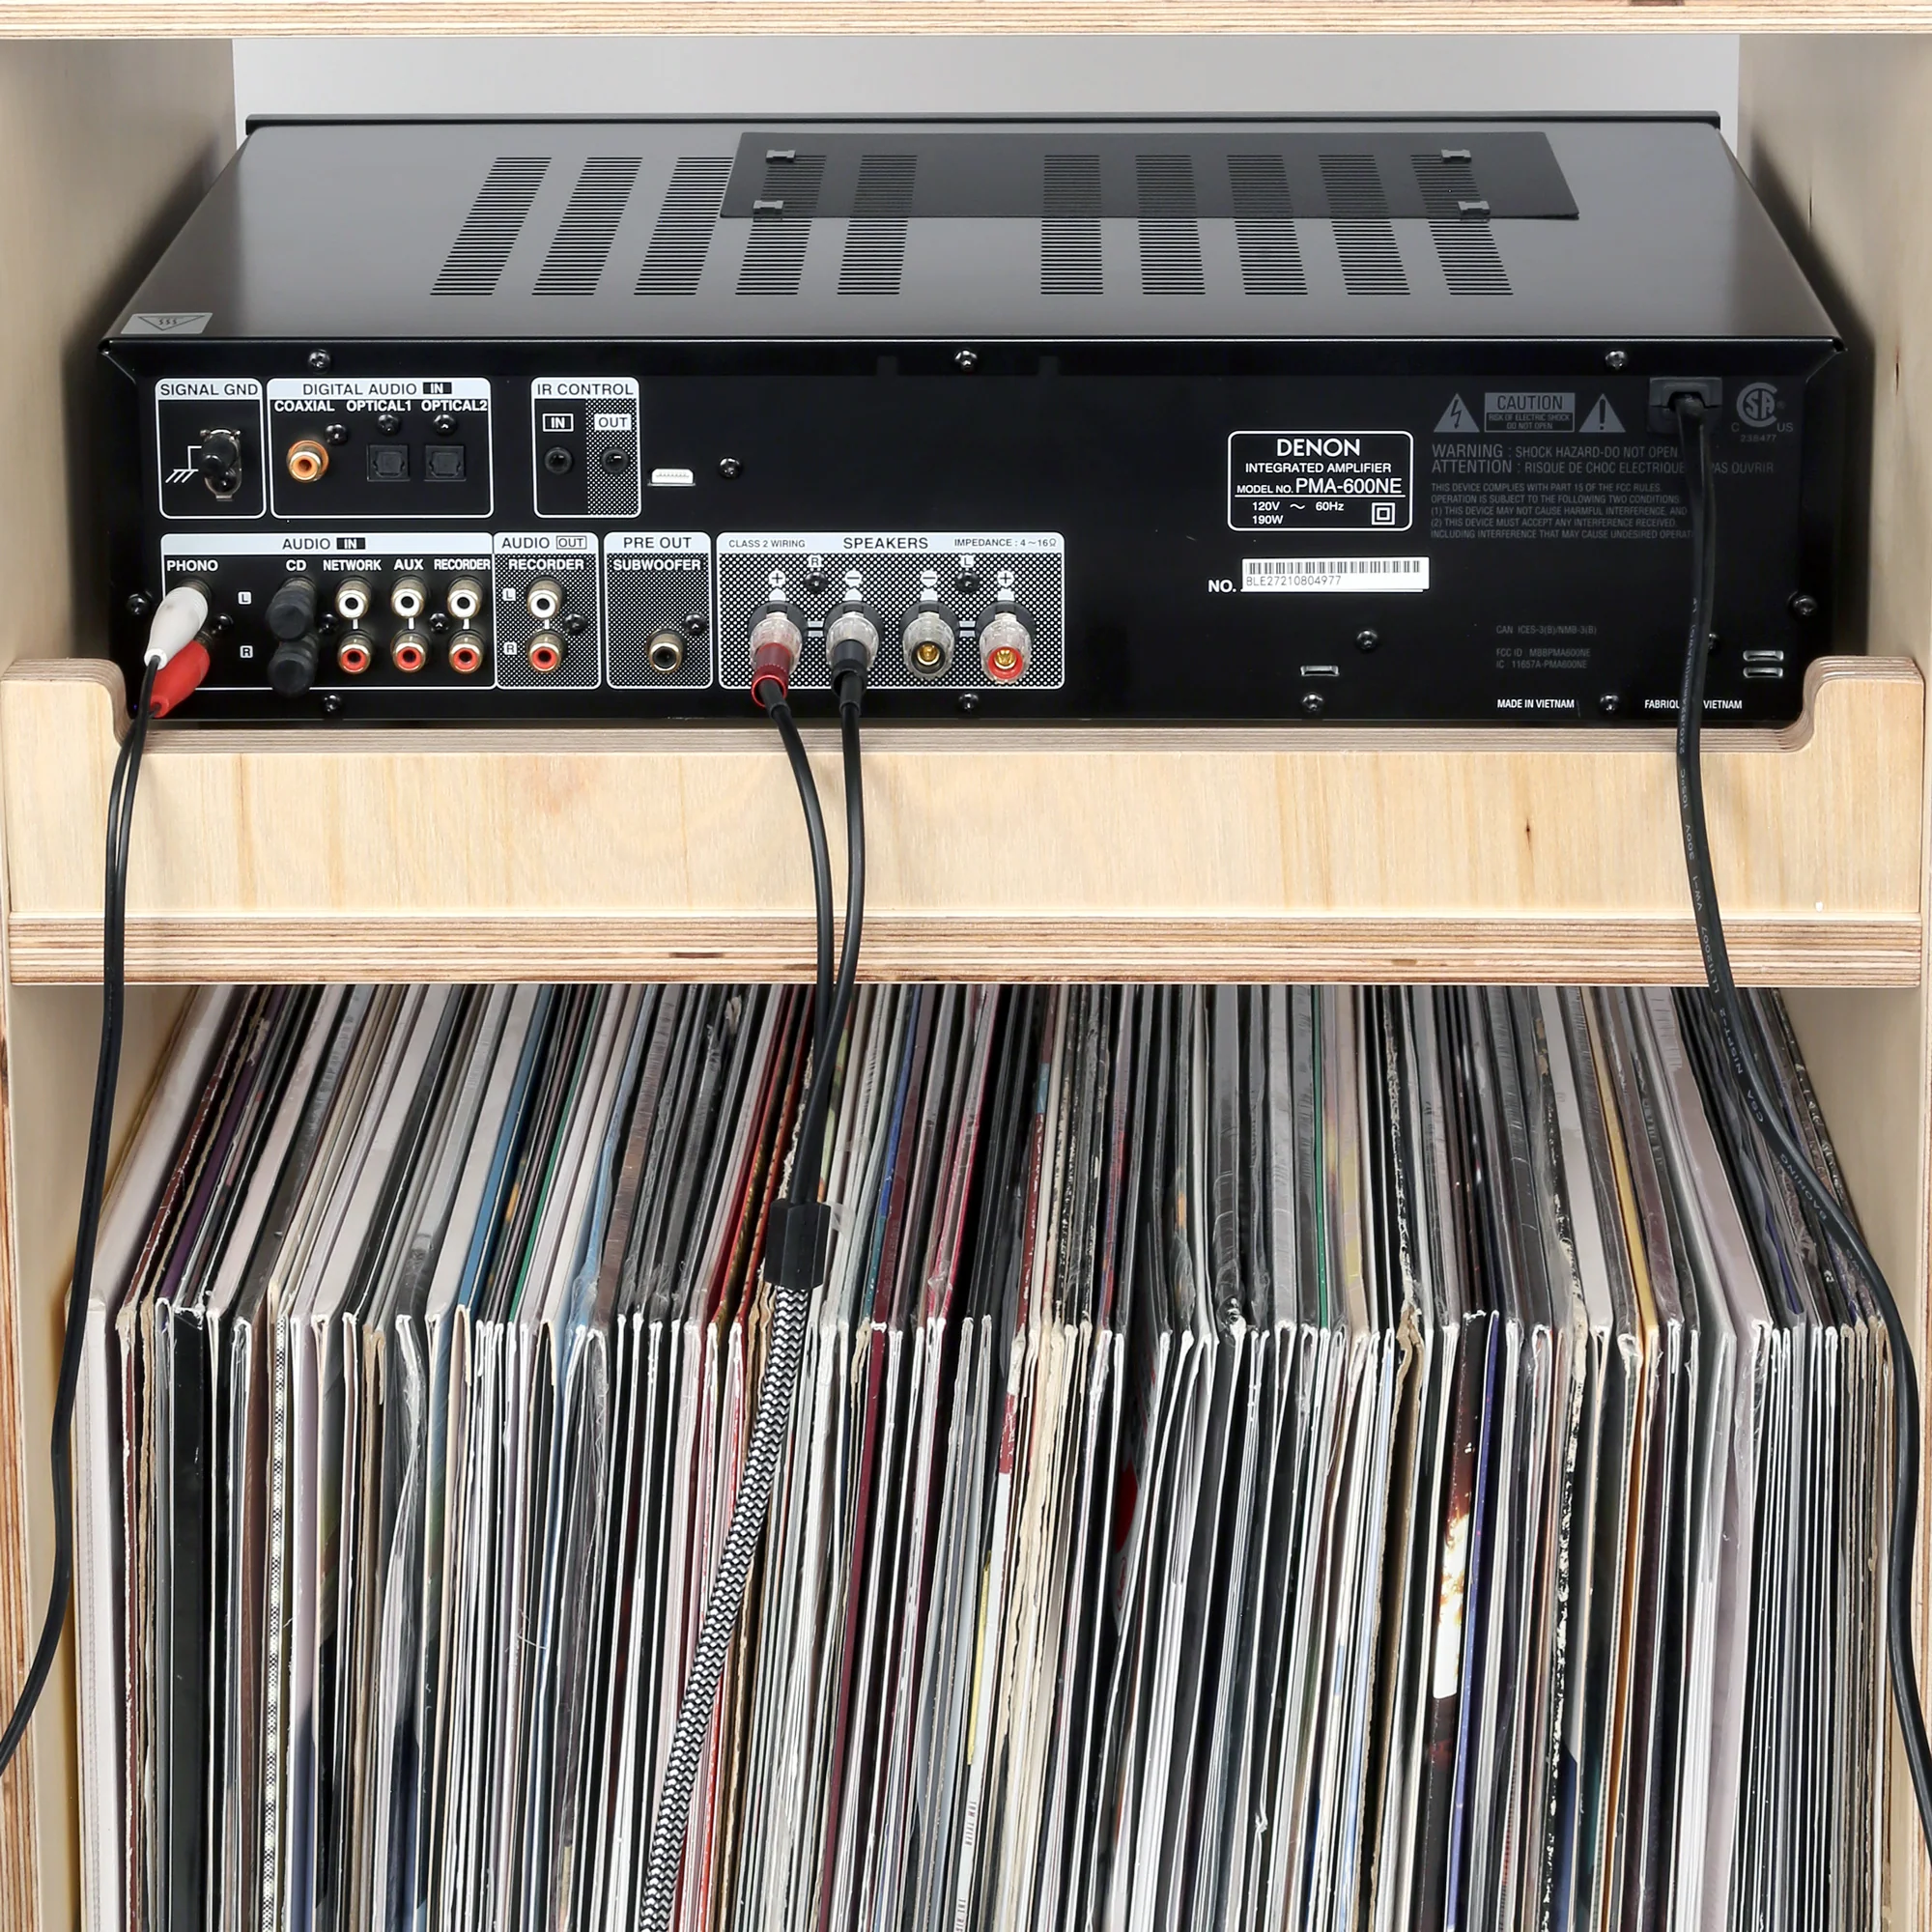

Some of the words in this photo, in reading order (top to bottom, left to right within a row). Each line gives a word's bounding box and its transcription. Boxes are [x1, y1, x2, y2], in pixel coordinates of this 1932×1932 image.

[160, 384, 219, 396] SIGNAL
[223, 384, 259, 396] GND
[302, 384, 363, 396] DIGITAL
[369, 384, 417, 396] AUDIO
[430, 383, 444, 394] IN
[537, 384, 553, 396] IR
[557, 384, 634, 396] CONTROL
[274, 400, 335, 412] COAXIAL
[346, 400, 412, 412] OPTICAL1
[421, 399, 488, 412] OPTICAL2
[1497, 394, 1563, 411] CAUTION
[551, 416, 566, 429] IN
[598, 416, 628, 429] OUT
[1776, 422, 1794, 432] US
[1276, 438, 1361, 457] DENON
[1432, 443, 1503, 459] WARNING
[1516, 446, 1552, 458] SHOCK
[1556, 446, 1620, 458] HAZARD-DO
[1624, 446, 1644, 458] NOT
[1649, 446, 1678, 458] OPEN
[1245, 463, 1323, 473] INTEGRATED
[1326, 463, 1392, 473] AMPLIFIER
[1432, 459, 1513, 474] ATTENTION
[1524, 462, 1565, 474] RISQUE
[1569, 462, 1582, 473] DE
[1586, 462, 1616, 473] CHOC
[1619, 462, 1686, 474] ELECTRIQUE
[1732, 462, 1775, 474] OUVRIR
[1236, 484, 1274, 494] MODEL
[1275, 484, 1294, 494] NO.
[1295, 477, 1403, 494] PMA-600NE
[1431, 483, 1450, 493] THIS
[1452, 483, 1481, 493] DEVICE
[1483, 483, 1525, 493] COMPLIES
[1527, 483, 1548, 493] WITH
[1550, 483, 1571, 493] PART
[1575, 483, 1584, 493] 15
[1586, 483, 1597, 493] OF
[1599, 483, 1613, 493] THE
[1616, 483, 1632, 493] FCC
[1431, 495, 1477, 504] OPERATION
[1479, 495, 1488, 504] IS
[1489, 495, 1525, 504] SUBJECT
[1528, 495, 1538, 504] TO
[1540, 495, 1555, 504] THE
[1558, 495, 1605, 504] FOLLOWING
[1608, 495, 1627, 504] TWO
[1252, 501, 1281, 511] 120V
[1315, 501, 1345, 511] 60Hz
[1431, 506, 1442, 516] (1)
[1445, 506, 1463, 516] THIS
[1465, 506, 1493, 516] DEVICE
[1496, 506, 1514, 516] MAY
[1517, 506, 1532, 516] NOT
[1535, 506, 1561, 516] CAUSE
[1564, 506, 1604, 516] HARMFUL
[1669, 506, 1688, 516] AND
[1252, 514, 1284, 525] 190W
[1431, 518, 1442, 527] (2)
[1445, 518, 1463, 527] THIS
[1465, 518, 1493, 527] DEVICE
[1496, 518, 1520, 527] MUST
[1521, 518, 1553, 527] ACCEPT
[1555, 518, 1571, 527] ANY
[1574, 518, 1634, 527] INTERFERENCE
[1431, 529, 1475, 539] INCLUDING
[1478, 529, 1537, 539] INTERFERENCE
[1540, 529, 1558, 539] THAT
[1561, 529, 1578, 539] MAY
[1581, 529, 1607, 539] CAUSE
[1610, 529, 1658, 539] UNDESIRED
[1660, 529, 1693, 539] OPERAT
[282, 538, 330, 551] AUDIO
[343, 538, 357, 550] IN
[501, 537, 550, 550] AUDIO
[558, 538, 584, 548] OUT
[623, 537, 654, 549] PRE
[659, 537, 692, 549] OUT
[842, 537, 929, 550] SPEAKERS
[953, 538, 1012, 548] IMPEDANCE
[166, 559, 218, 572] PHONO
[285, 559, 307, 572] CD
[323, 559, 383, 572] NETWORK
[393, 559, 424, 571] AUX
[434, 558, 491, 571] RECORDER
[508, 558, 584, 571] RECORDER
[612, 558, 701, 571] SUBWOOFER
[810, 556, 820, 566] R
[964, 556, 972, 566] L
[1208, 580, 1237, 593] NO.
[1495, 625, 1514, 636] CAN
[242, 646, 251, 657] R
[506, 643, 515, 654] R
[1495, 648, 1512, 657] FCC
[1514, 648, 1522, 657] ID
[1497, 698, 1522, 709] MADE
[1524, 698, 1534, 709] IN
[1535, 698, 1575, 709] VIETNAM
[1703, 699, 1743, 709] VIETNAM
[1685, 823, 1696, 860] 300V
[1691, 874, 1703, 911] VW-1
[1719, 1007, 1744, 1074] NISPT-2
[1746, 1089, 1765, 1122] CSA
